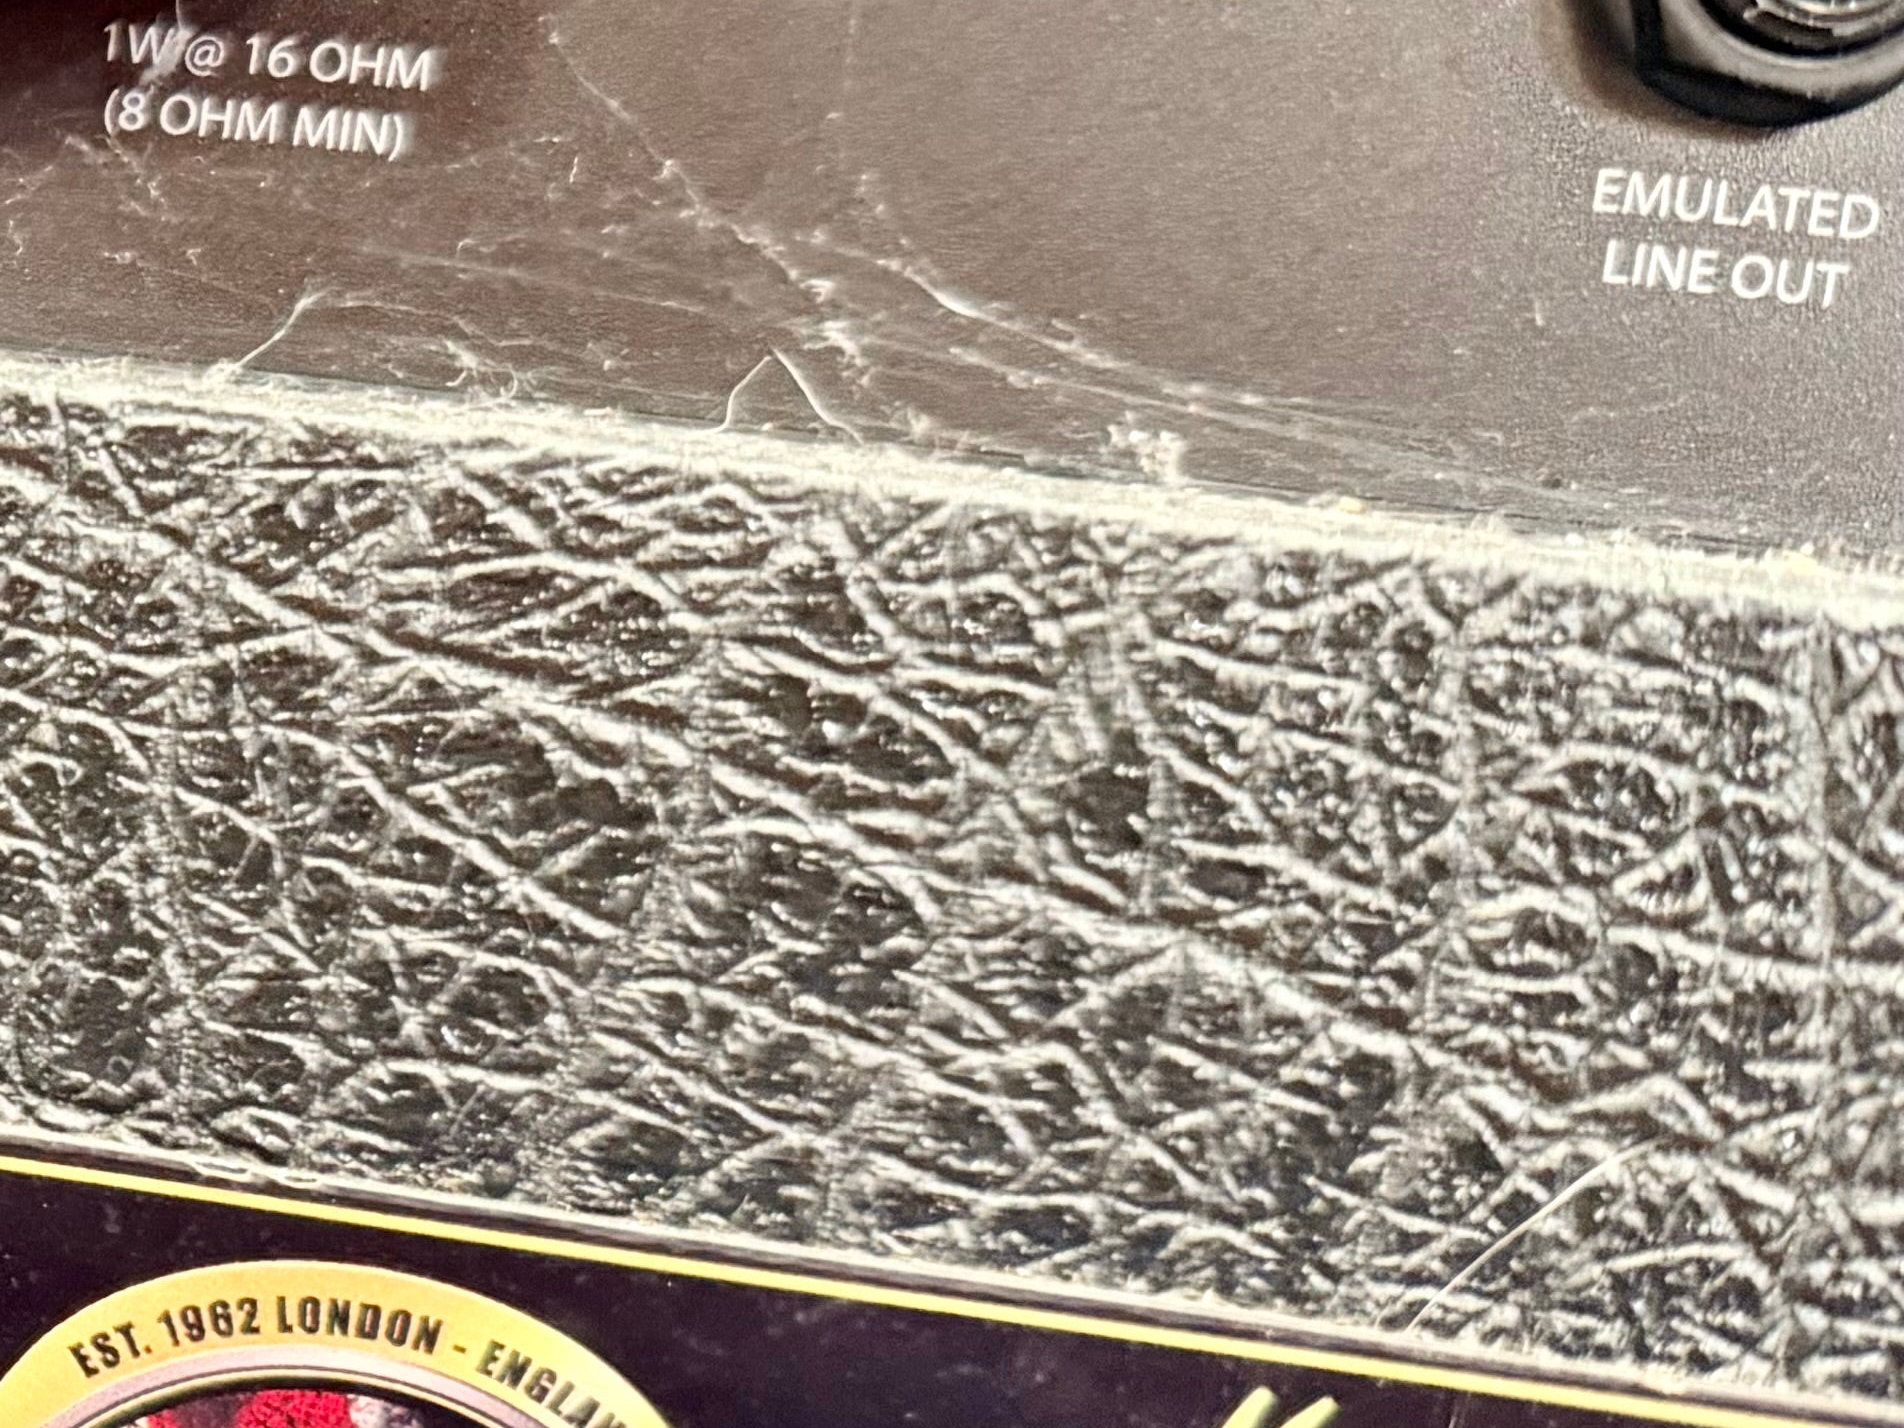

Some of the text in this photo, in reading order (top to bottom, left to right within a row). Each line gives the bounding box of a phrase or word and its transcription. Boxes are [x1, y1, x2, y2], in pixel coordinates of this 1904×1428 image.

[245, 31, 297, 77] 16
[309, 40, 434, 92] OHM
[104, 88, 405, 163] (8 OHM MIN)
[1590, 167, 1880, 241] EMULATED
[1600, 241, 1852, 309] LINE OUT
[67, 1323, 152, 1379] EST.
[157, 1296, 261, 1347] 1962
[275, 1295, 444, 1354] LONDON
